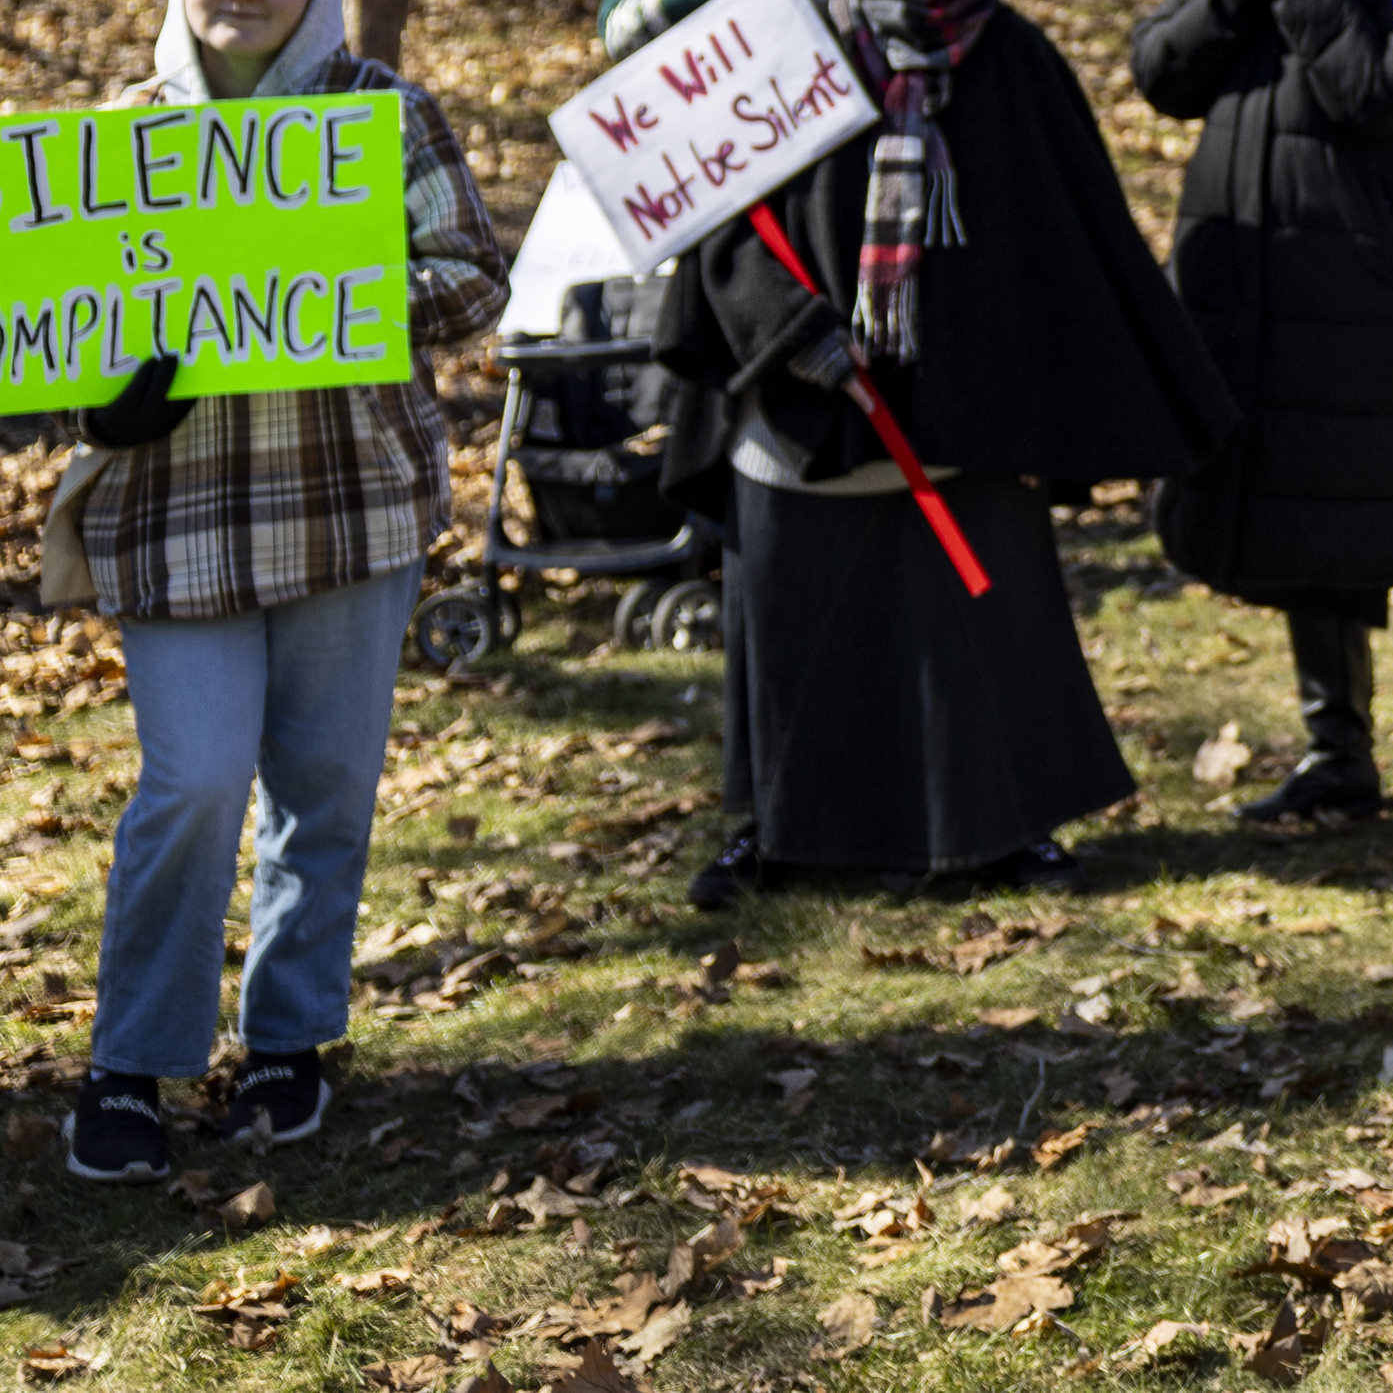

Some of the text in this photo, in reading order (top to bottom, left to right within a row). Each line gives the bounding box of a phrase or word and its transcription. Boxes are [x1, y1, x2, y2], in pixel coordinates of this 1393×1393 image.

[590, 18, 754, 153] We Will
[622, 51, 853, 240] Not be Silent
[0, 107, 374, 229] ILENCE
[120, 232, 171, 272] is
